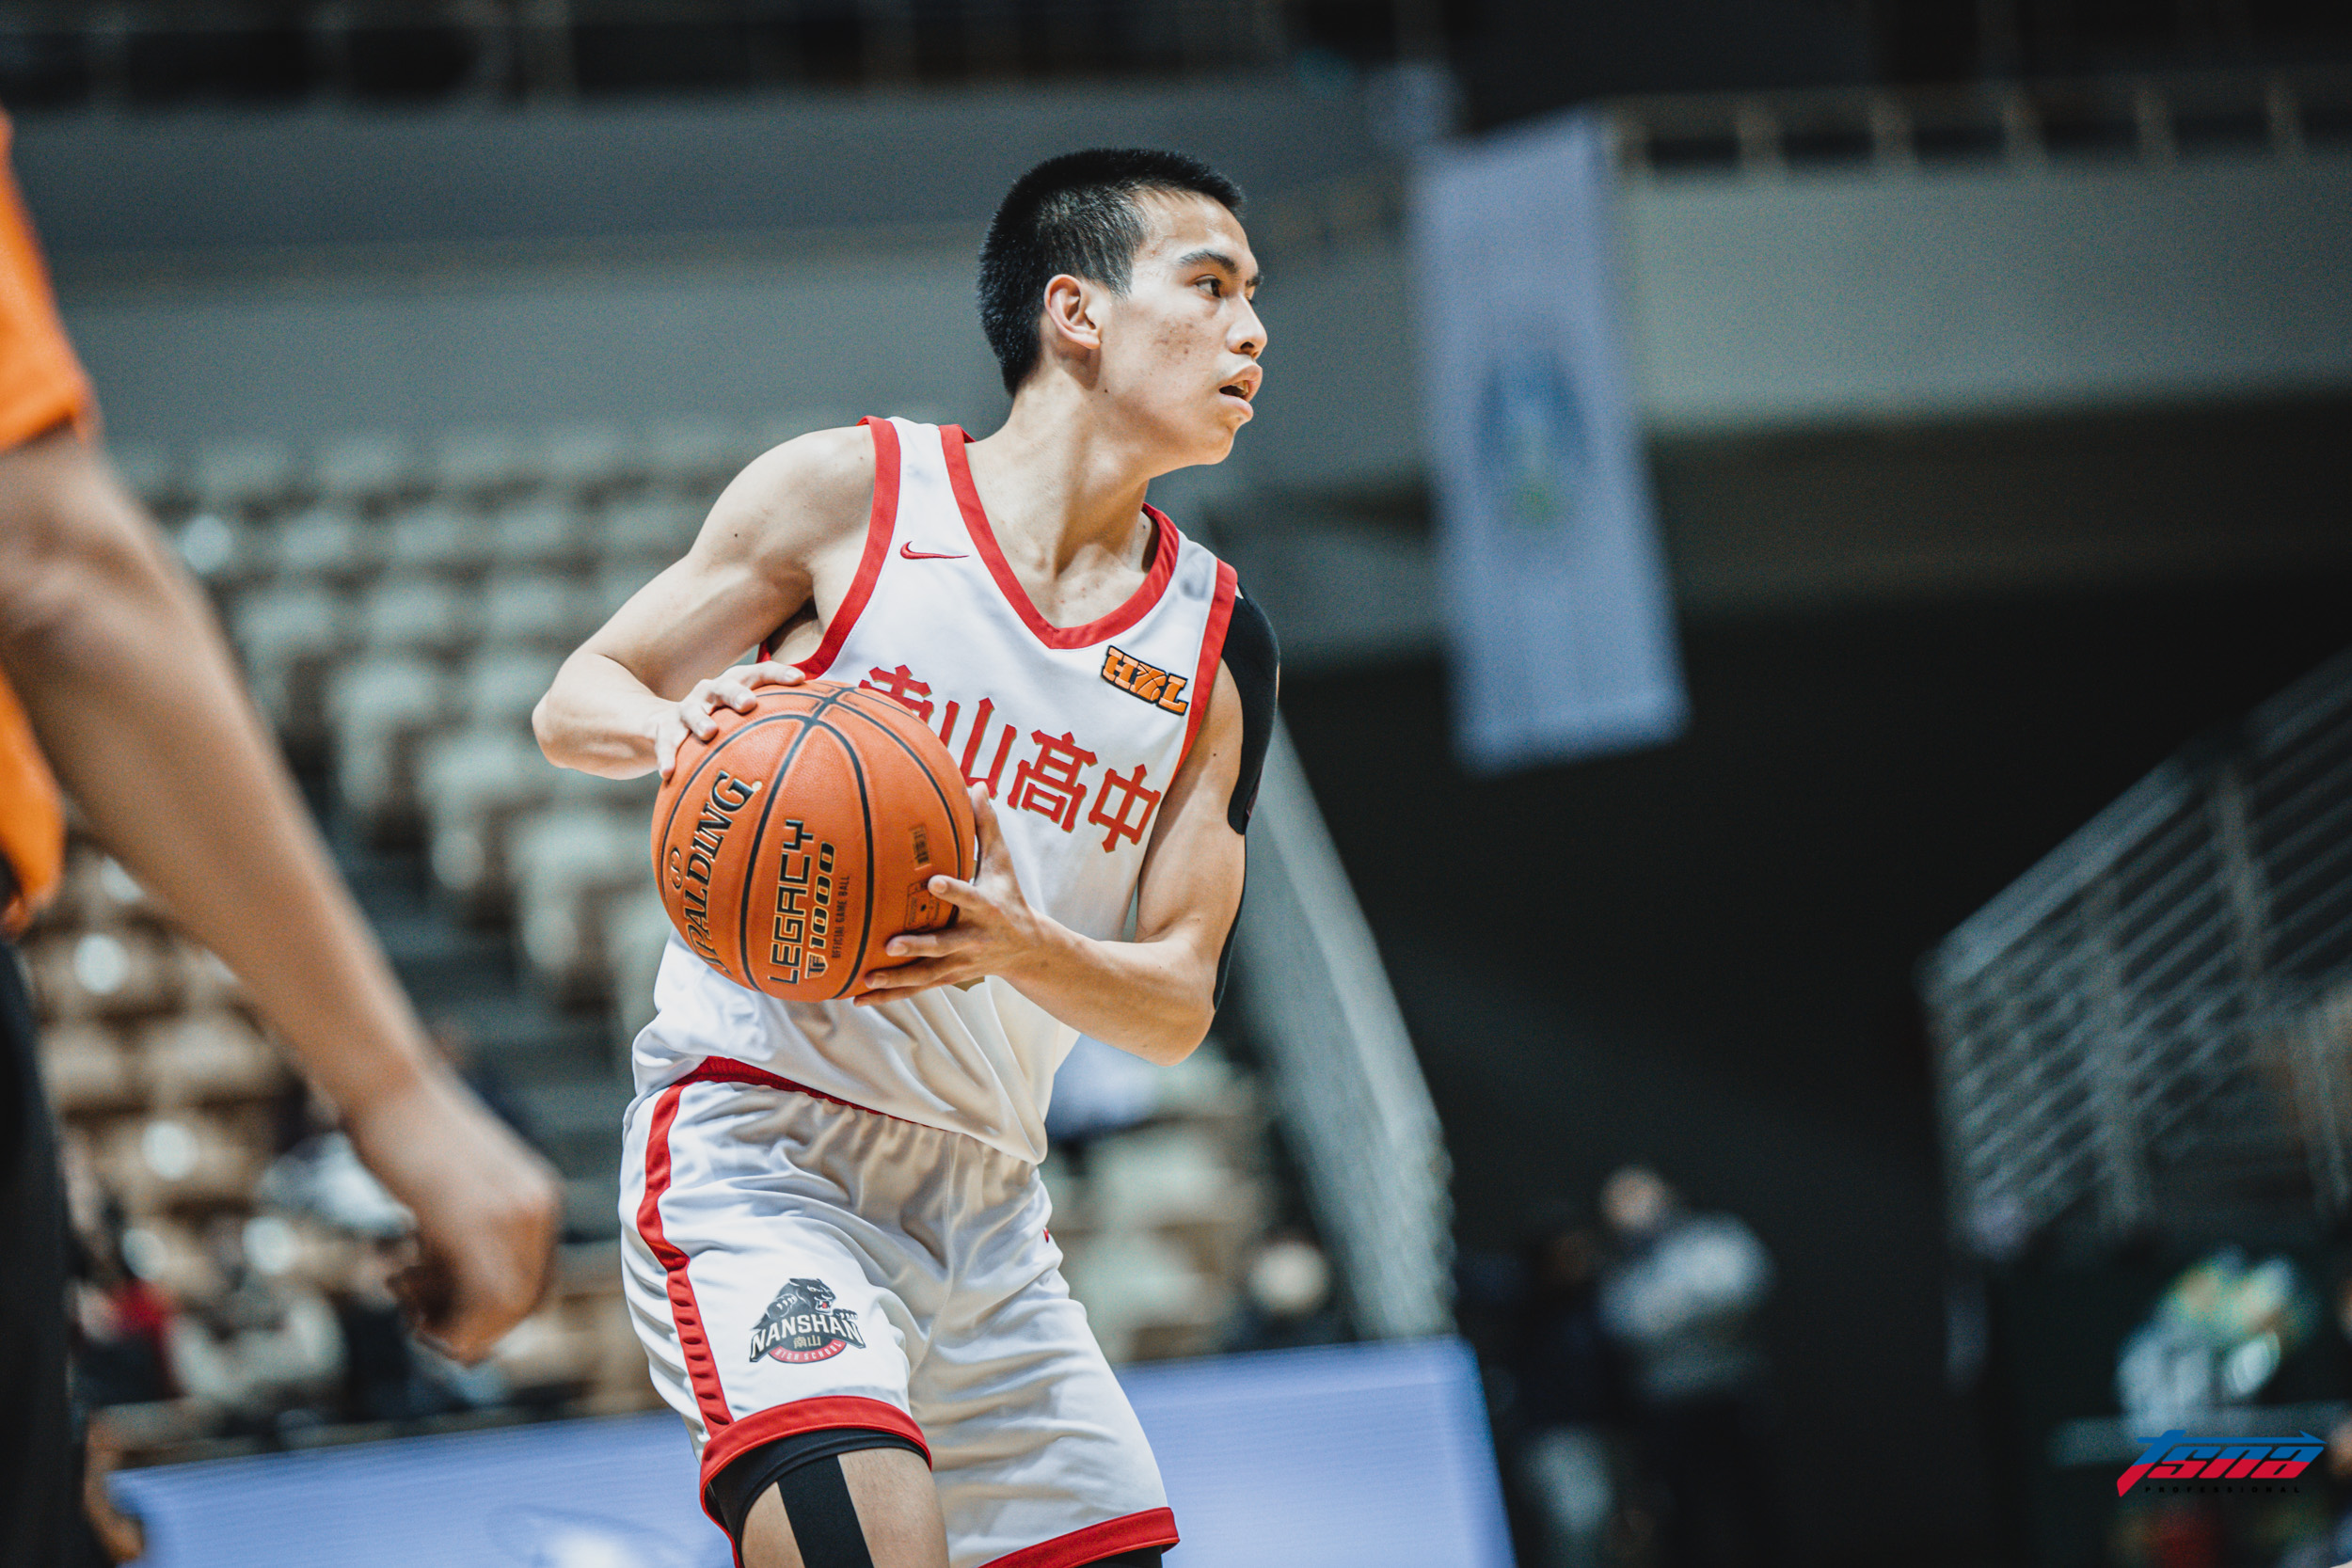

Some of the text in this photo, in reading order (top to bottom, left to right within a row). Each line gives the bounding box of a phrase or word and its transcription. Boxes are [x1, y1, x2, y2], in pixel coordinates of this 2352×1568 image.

[683, 769, 756, 975] SPALDING
[768, 819, 814, 985] LEGACY
[831, 876, 850, 958] OFFICIAL GAME BALL
[751, 1314, 864, 1359] NANSHAN
[775, 1341, 842, 1360] HIGH SCHOOL
[793, 1335, 821, 1350] 南山
